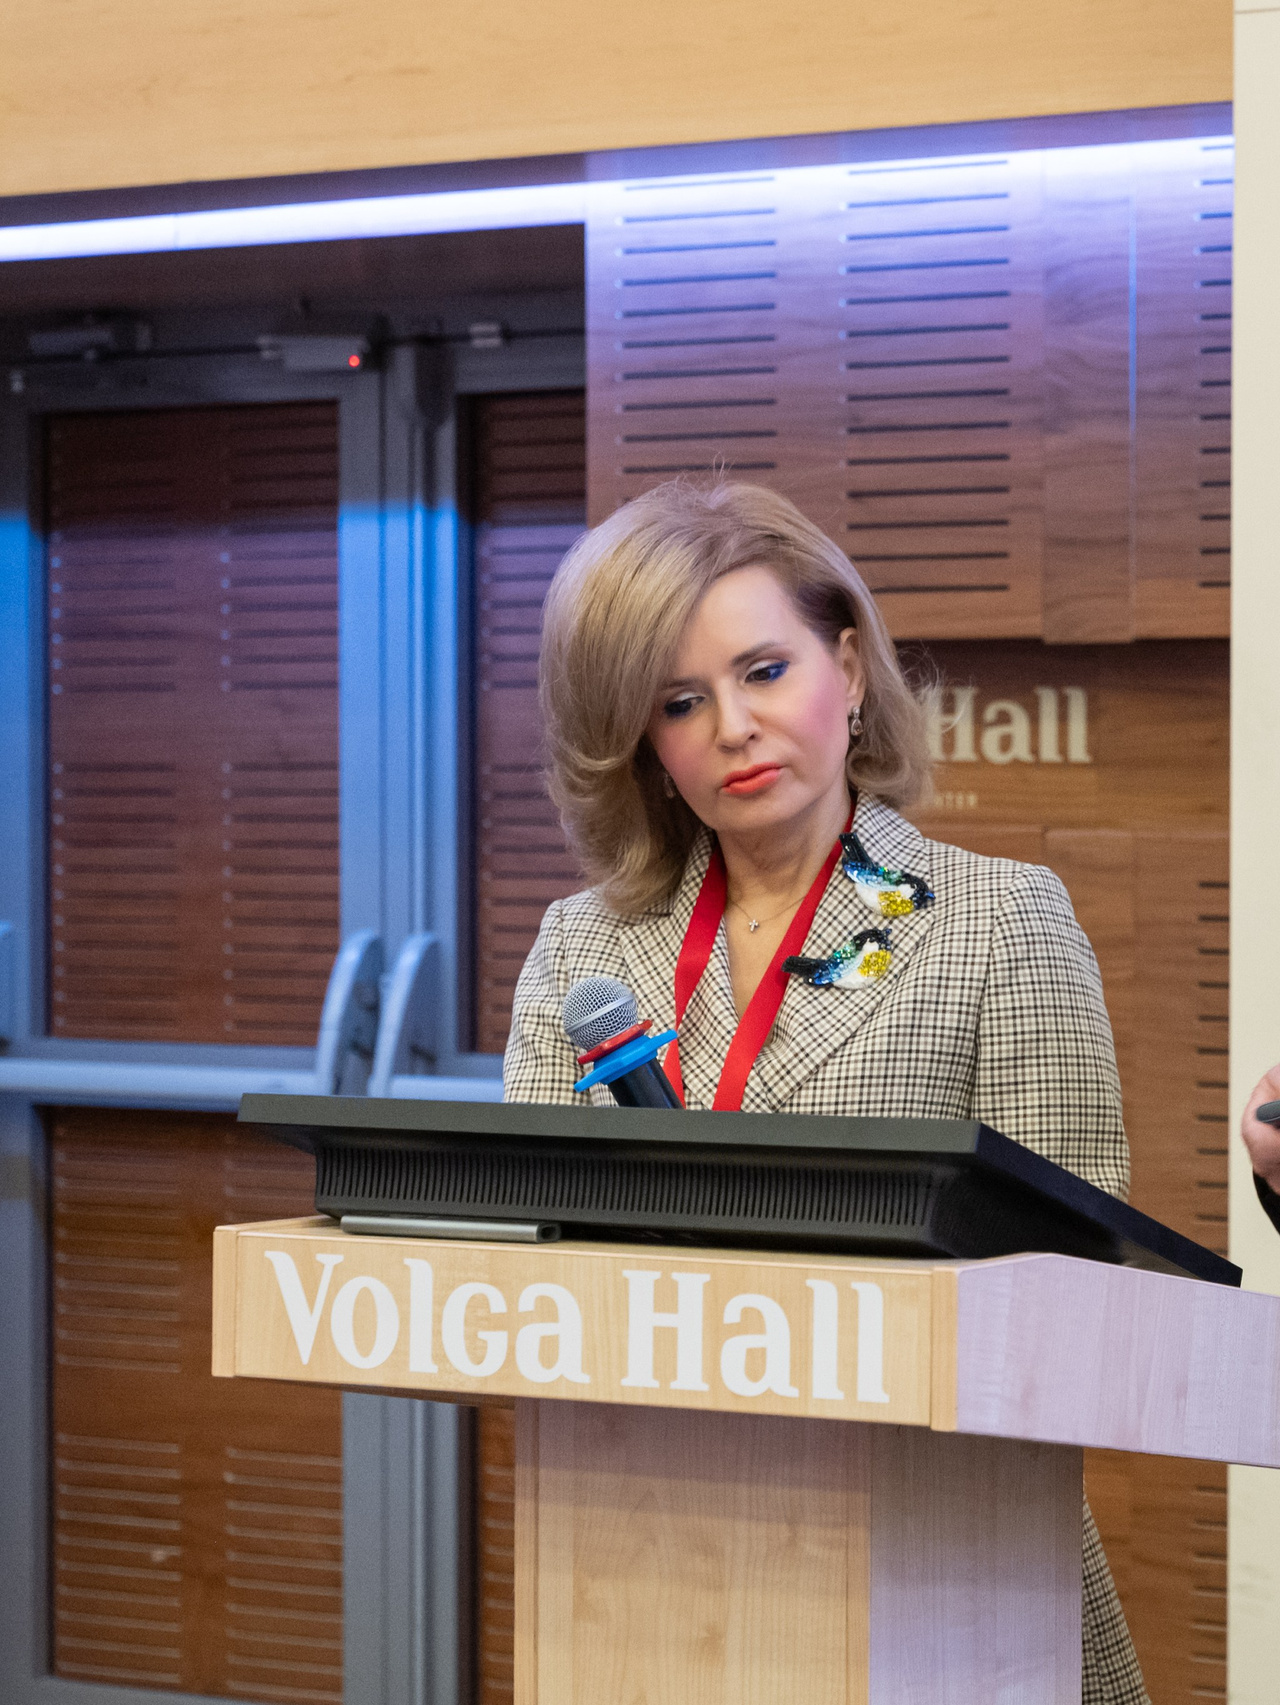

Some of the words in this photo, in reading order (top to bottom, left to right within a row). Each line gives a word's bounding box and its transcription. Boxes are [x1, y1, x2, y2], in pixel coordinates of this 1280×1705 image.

[924, 686, 1092, 765] Hall
[264, 1250, 591, 1384] Volga
[620, 1269, 890, 1404] Hall
